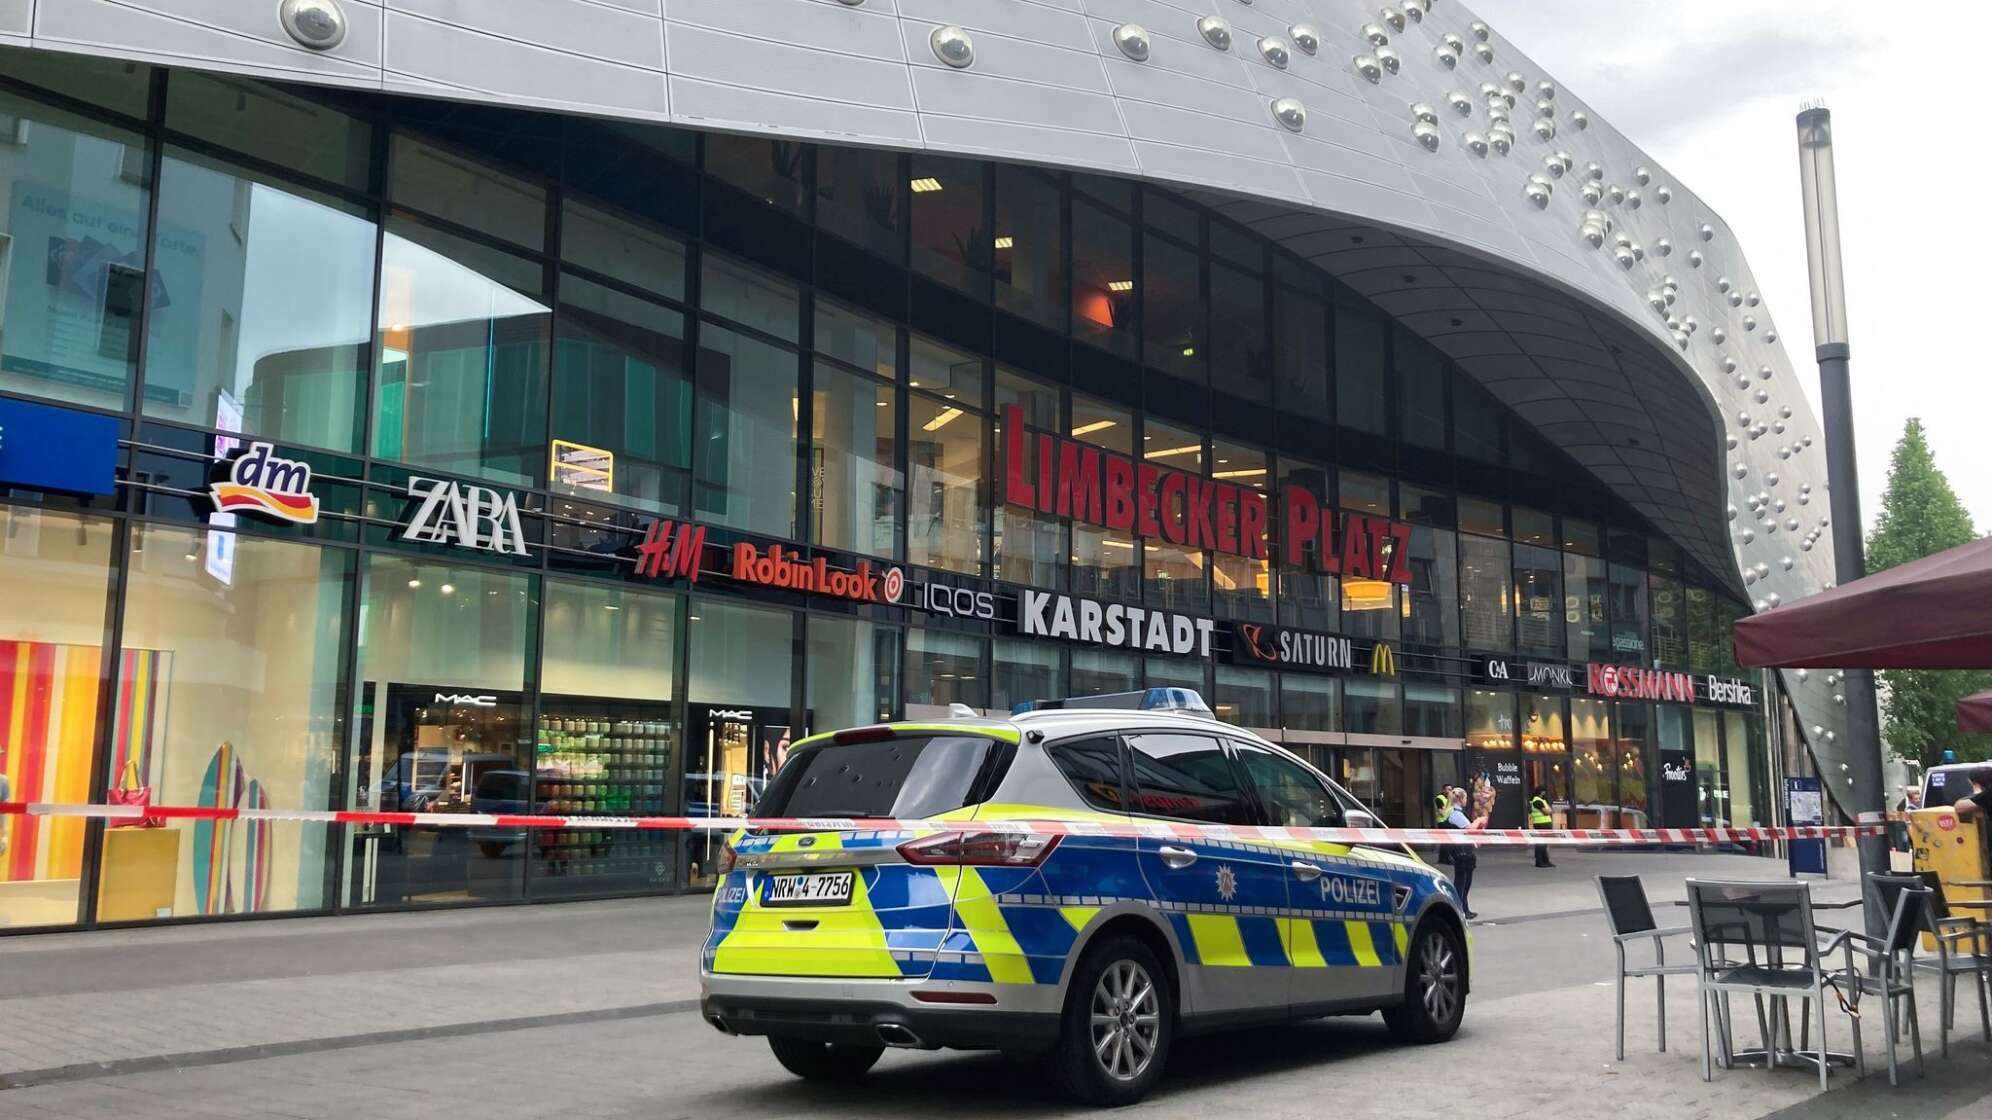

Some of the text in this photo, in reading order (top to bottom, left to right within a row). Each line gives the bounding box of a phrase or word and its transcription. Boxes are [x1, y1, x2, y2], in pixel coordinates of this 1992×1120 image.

[236, 447, 307, 494] dm
[1003, 404, 1414, 583] LIMBECKER PLATZ
[402, 476, 533, 557] ZARA
[635, 518, 705, 583] H&M
[924, 582, 994, 618] IQOS
[1023, 589, 1214, 657] KARSTADT
[1279, 629, 1352, 669] SATURN
[1488, 659, 1509, 680] C&A
[1529, 665, 1573, 686] MONKI
[1587, 662, 1696, 704] ROSSMANN
[1708, 675, 1752, 705] Bershka
[770, 875, 849, 900] NRW 4-7756
[1320, 876, 1381, 905] POLIZEI
